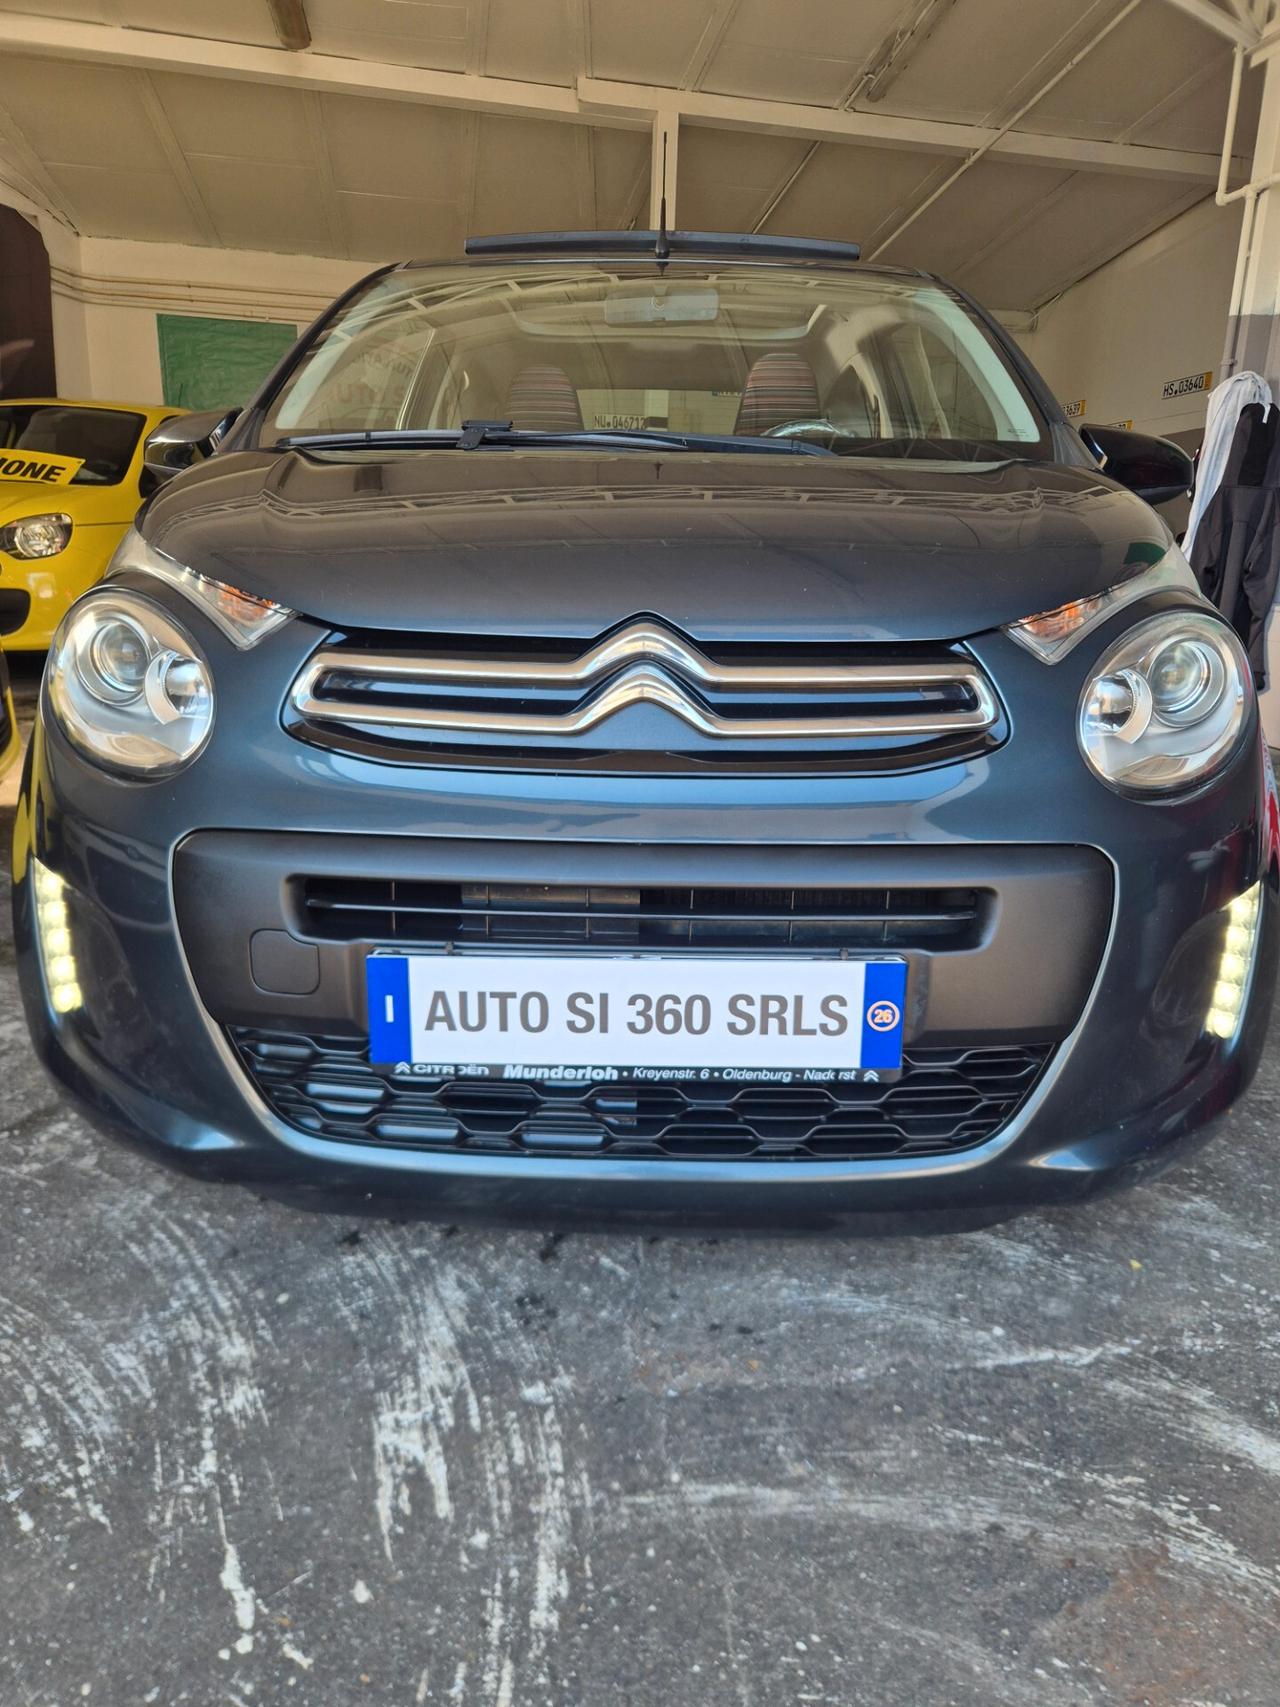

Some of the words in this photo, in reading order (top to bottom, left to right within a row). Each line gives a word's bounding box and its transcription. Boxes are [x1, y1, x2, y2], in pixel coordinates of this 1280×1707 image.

[424, 990, 549, 1033] AUTO
[566, 991, 609, 1034] SI
[626, 993, 711, 1036] 360
[726, 993, 849, 1037] SRLS
[873, 1009, 893, 1024] 26
[503, 1063, 619, 1080] Munderloh
[633, 1067, 696, 1081] Kreyenstr.
[700, 1068, 710, 1080] 6
[722, 1068, 793, 1083] Oldenburg
